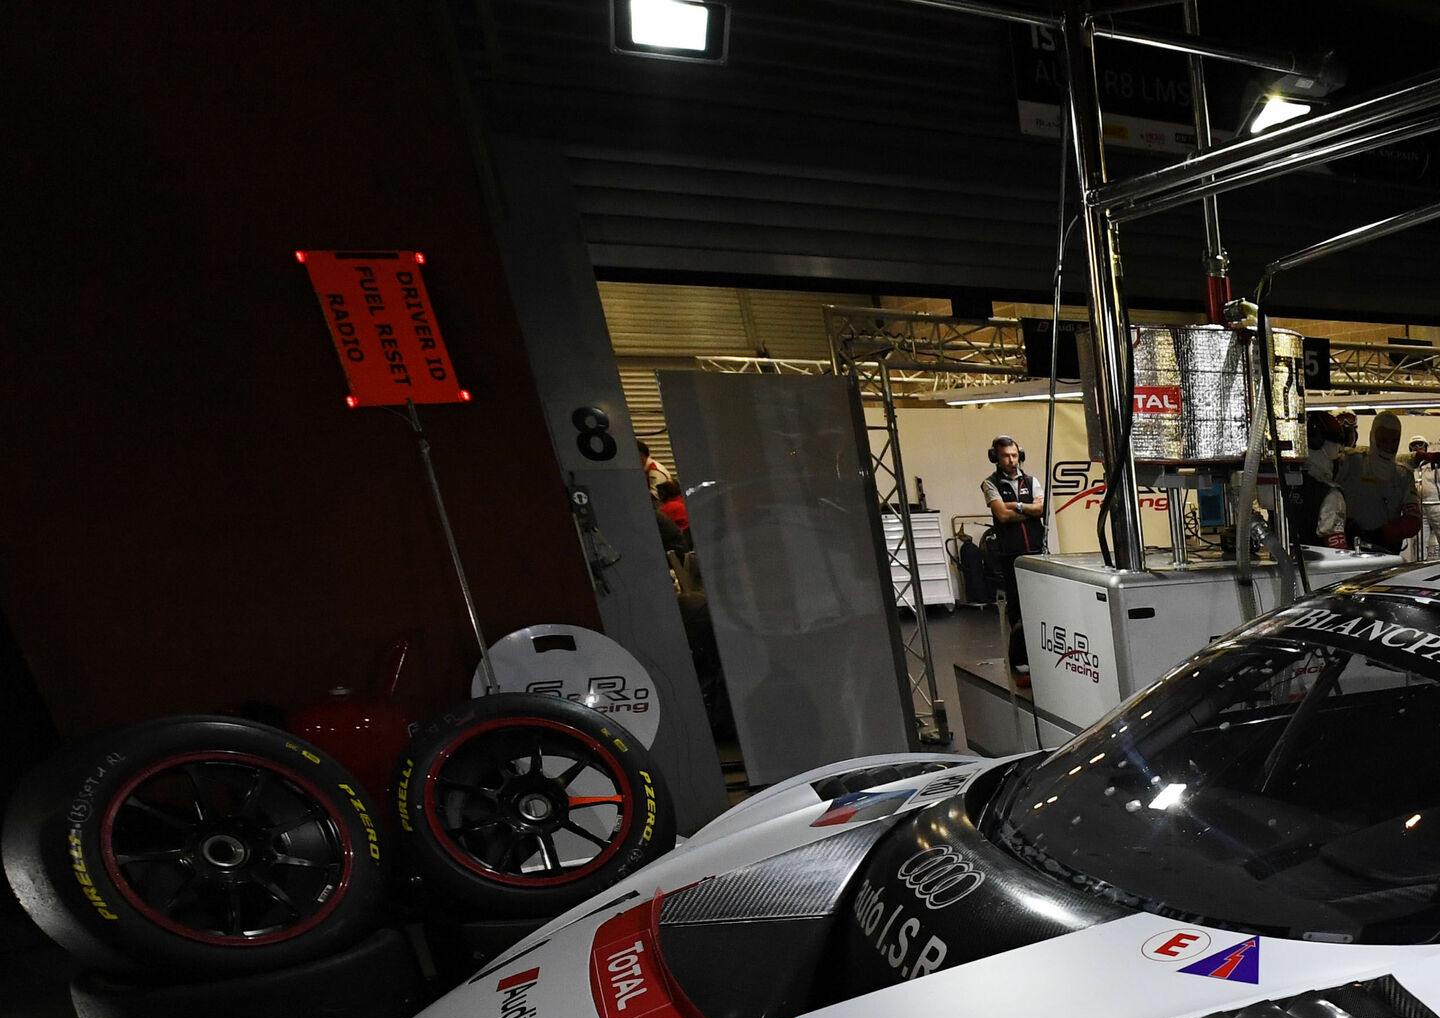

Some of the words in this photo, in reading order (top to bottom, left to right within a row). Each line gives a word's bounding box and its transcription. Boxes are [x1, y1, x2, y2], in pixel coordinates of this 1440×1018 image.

[326, 292, 365, 364] RADIO
[354, 265, 385, 318] FUEL
[374, 323, 412, 387] RESET
[396, 270, 439, 352] DRIVER
[429, 355, 447, 381] ID
[571, 406, 617, 462] 8
[1134, 394, 1178, 410] TAL
[1065, 660, 1100, 683] racing
[397, 758, 416, 832] PIRELLI
[854, 879, 885, 937] auto
[607, 941, 648, 1012] TOTAL
[1154, 933, 1201, 957] E
